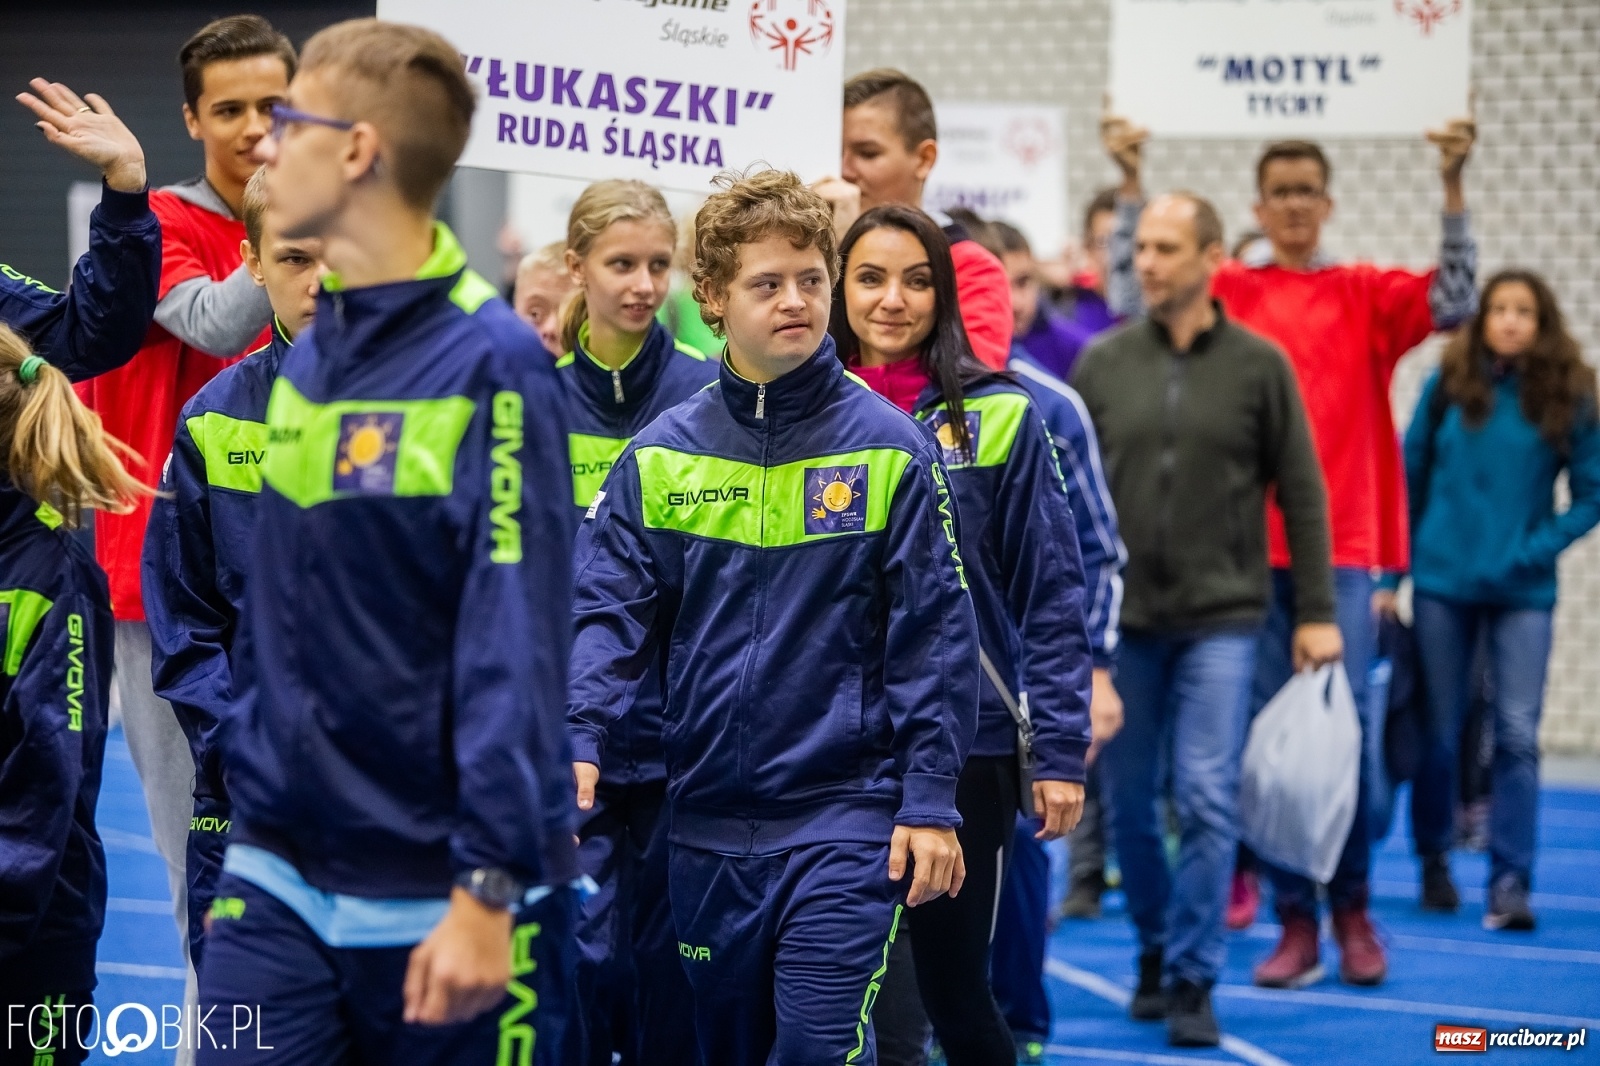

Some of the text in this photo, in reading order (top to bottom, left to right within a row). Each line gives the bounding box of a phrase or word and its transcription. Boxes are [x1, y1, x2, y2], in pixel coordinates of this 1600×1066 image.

[659, 18, 729, 48] Śląskie
[497, 112, 725, 168] RUDA ŚLĄSKA
[228, 450, 267, 465] GIV
[571, 461, 613, 476] OVA
[490, 390, 524, 565] GIVOVA
[667, 486, 750, 507] GIVOVA
[931, 461, 969, 590] GIVOVA
[66, 613, 84, 732] GIVOVA
[678, 940, 711, 962] VOVA
